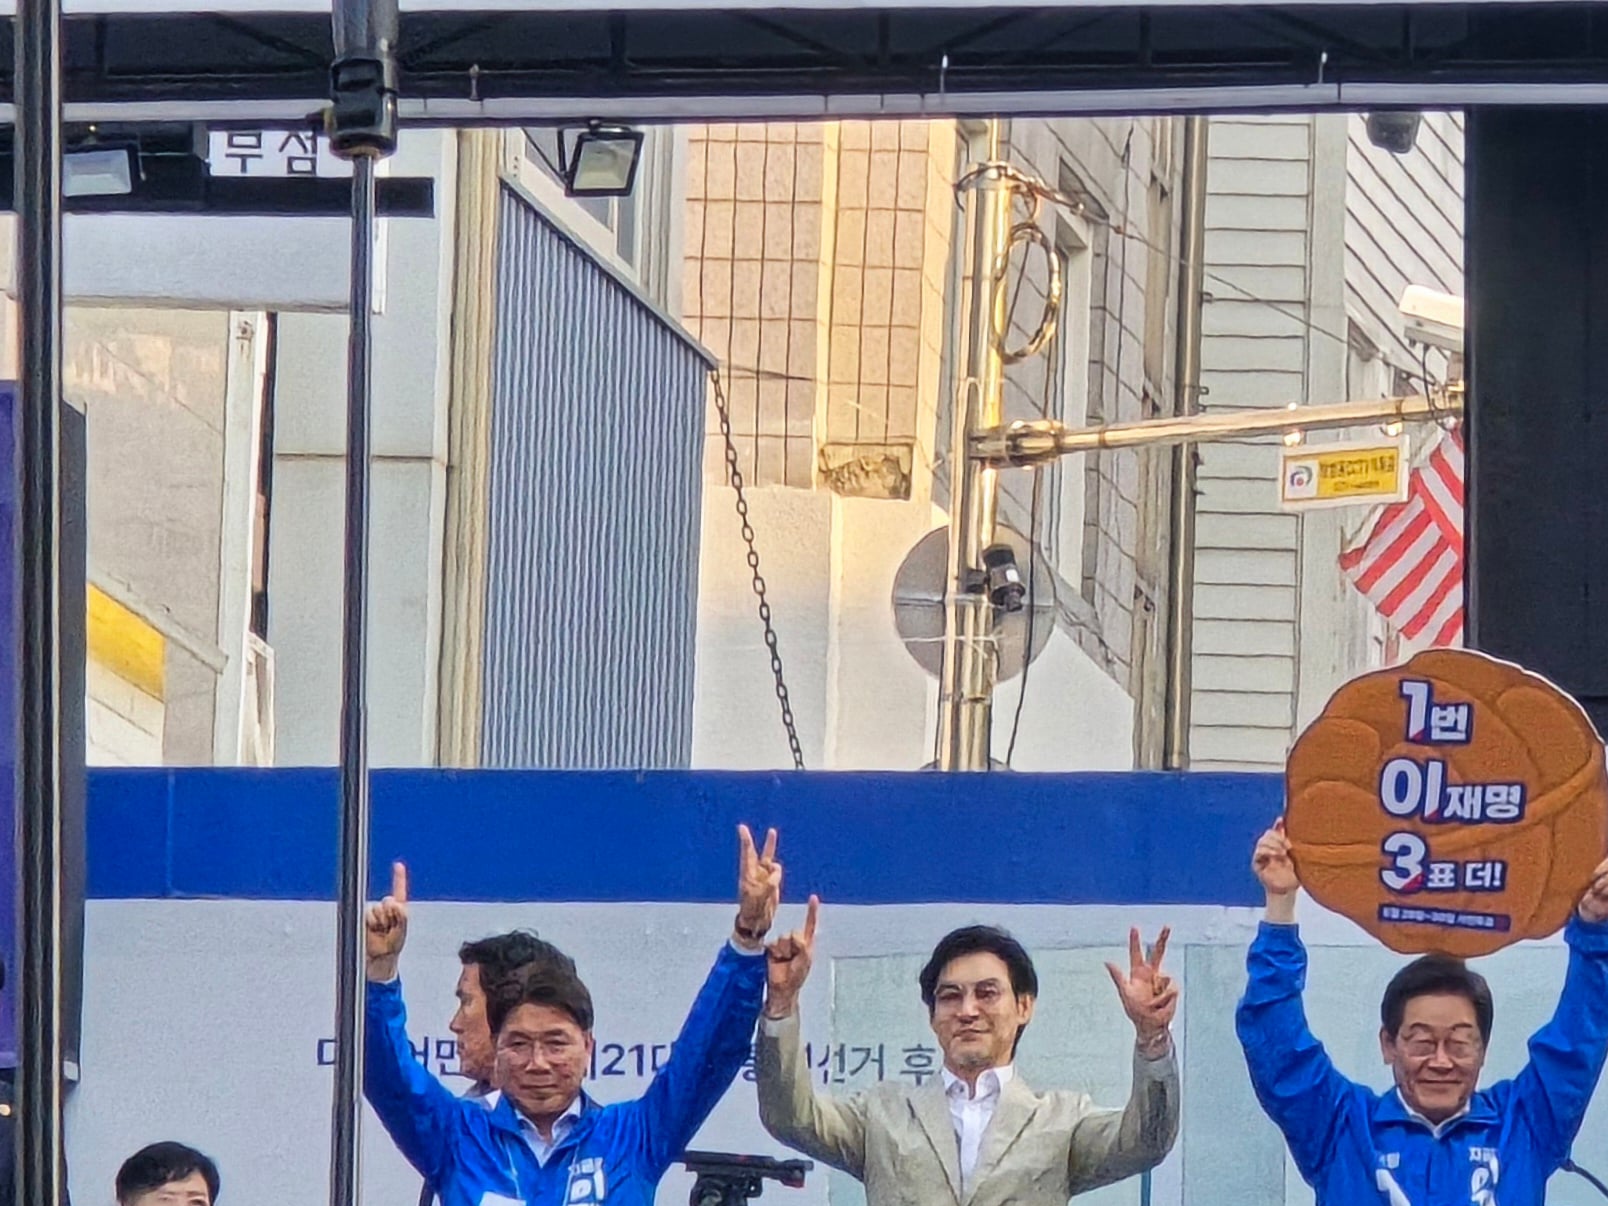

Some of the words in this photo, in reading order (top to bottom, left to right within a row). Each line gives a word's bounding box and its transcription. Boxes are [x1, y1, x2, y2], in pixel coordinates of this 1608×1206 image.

[1402, 681, 1470, 741] 1번
[1380, 757, 1522, 820] 이재명
[1381, 832, 1456, 891] 3표
[1464, 862, 1503, 888] 더!
